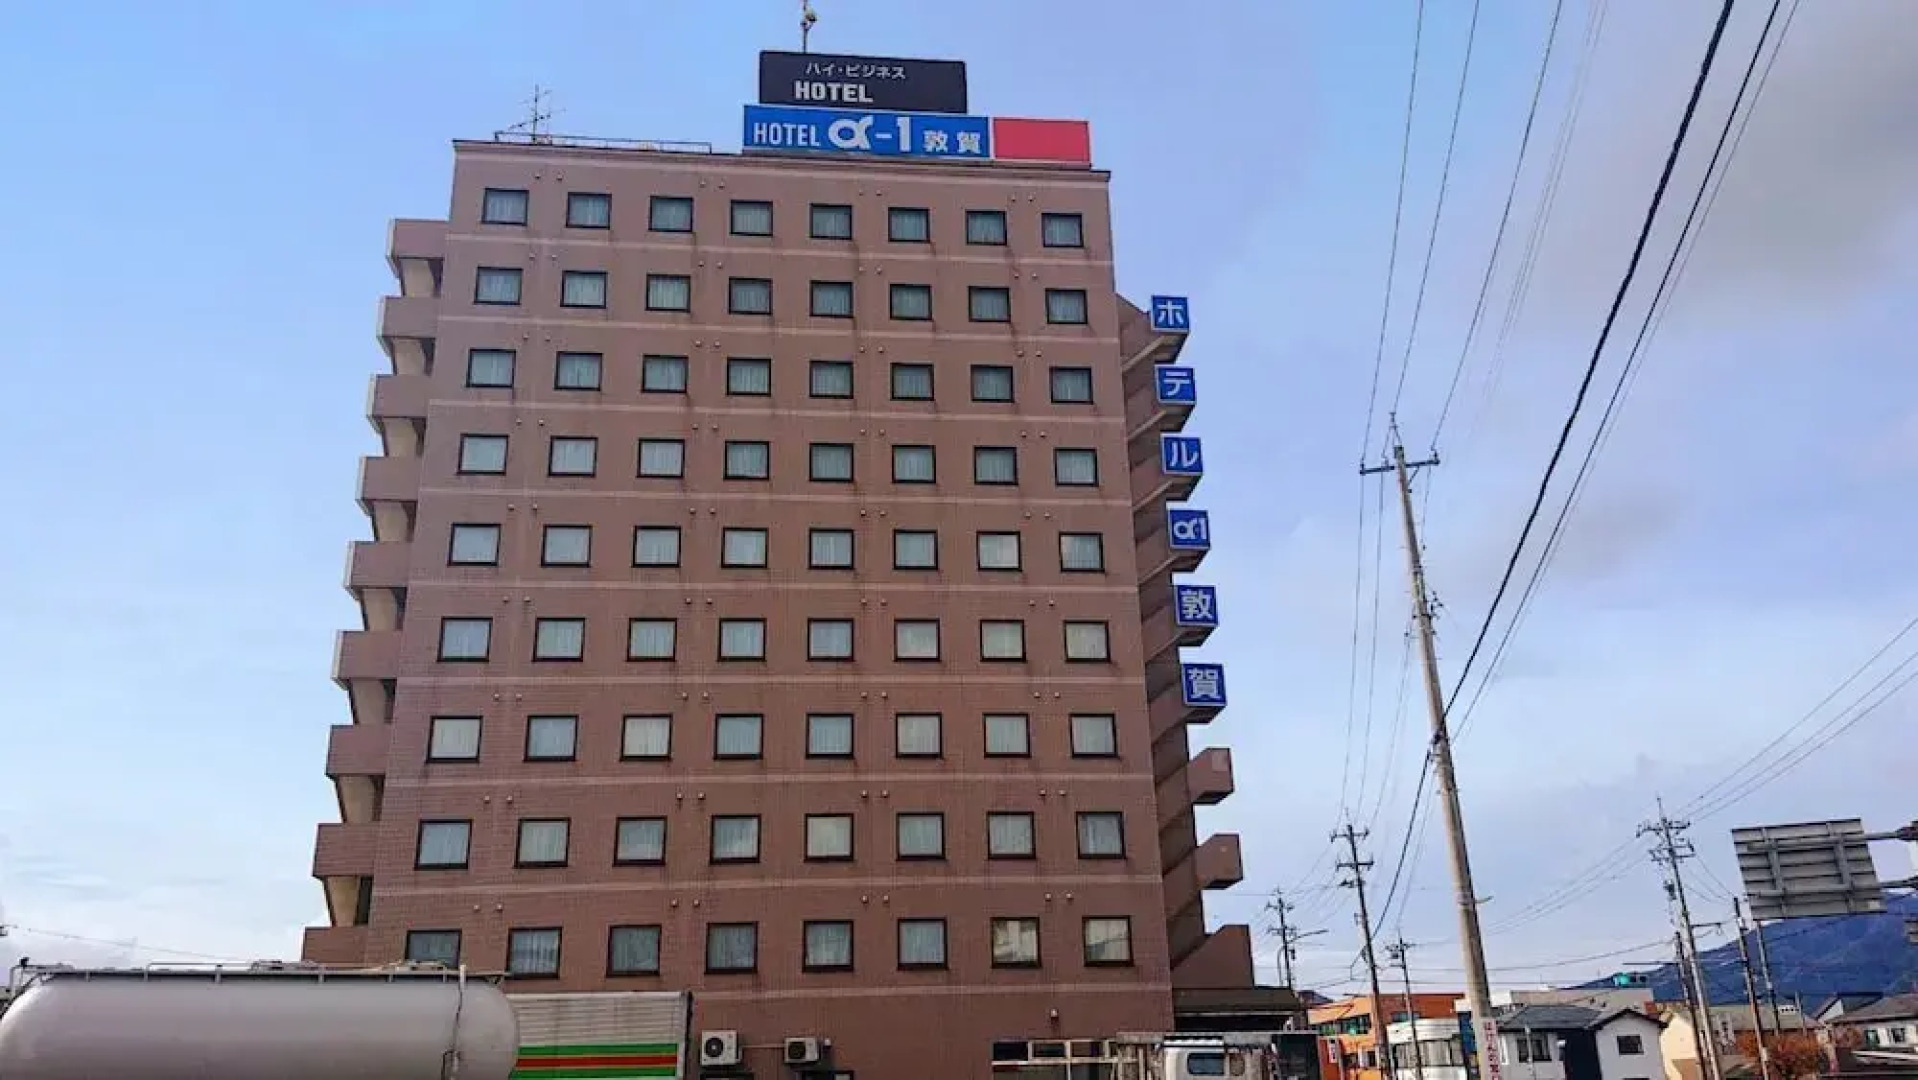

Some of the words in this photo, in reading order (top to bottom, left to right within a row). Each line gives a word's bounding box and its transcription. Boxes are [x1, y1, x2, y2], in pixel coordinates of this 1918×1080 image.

[805, 62, 906, 80] ハイ・ビジネス
[795, 80, 873, 103] HOTEL
[753, 122, 820, 147] HOTEL
[923, 130, 982, 154] 敦賀
